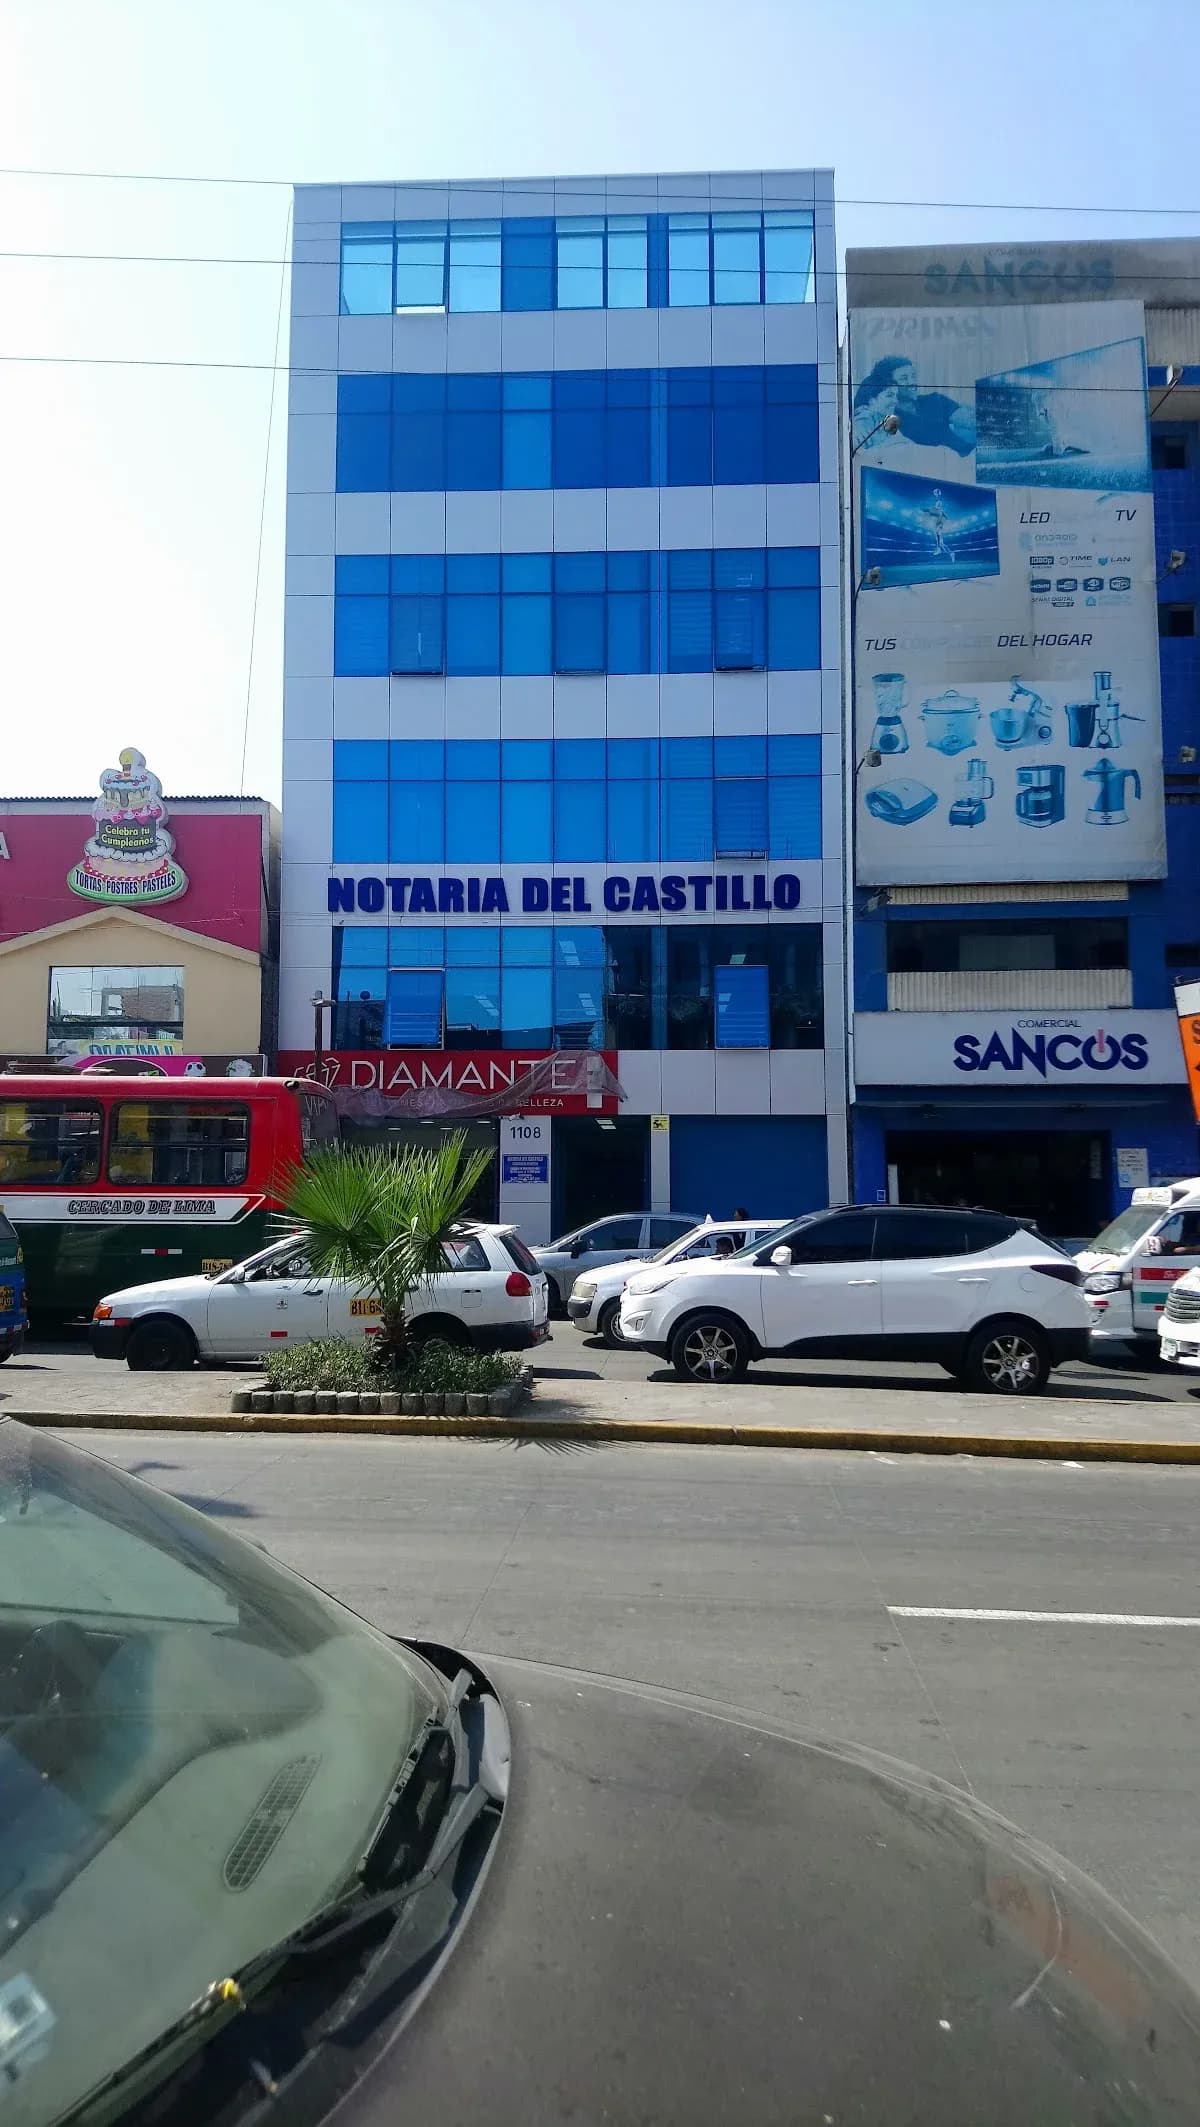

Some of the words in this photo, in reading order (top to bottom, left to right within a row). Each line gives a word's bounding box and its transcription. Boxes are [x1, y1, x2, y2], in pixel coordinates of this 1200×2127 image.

[1019, 512, 1050, 524] LED
[1115, 509, 1137, 522] TV
[865, 638, 897, 651] TUS
[997, 634, 1029, 648] DEL
[1032, 633, 1093, 647] HOGAR
[105, 825, 139, 836] Celebra
[141, 826, 150, 836] tu
[101, 834, 154, 848] Cumpleaños
[75, 869, 102, 893] TORTAS
[106, 879, 138, 895] POSTRES
[142, 870, 176, 893] PASTELES
[328, 877, 509, 913] NOTARIA
[522, 876, 592, 912] DEL
[603, 873, 801, 912] CASTILLO
[1017, 1019, 1081, 1028] COMERCIAL
[953, 1027, 1149, 1078] SANCOS
[350, 1060, 577, 1090] DIAMANTE
[510, 1126, 541, 1139] 1108
[67, 1199, 145, 1215] CERCADO
[147, 1199, 172, 1215] DE
[173, 1199, 217, 1215] LIMA
